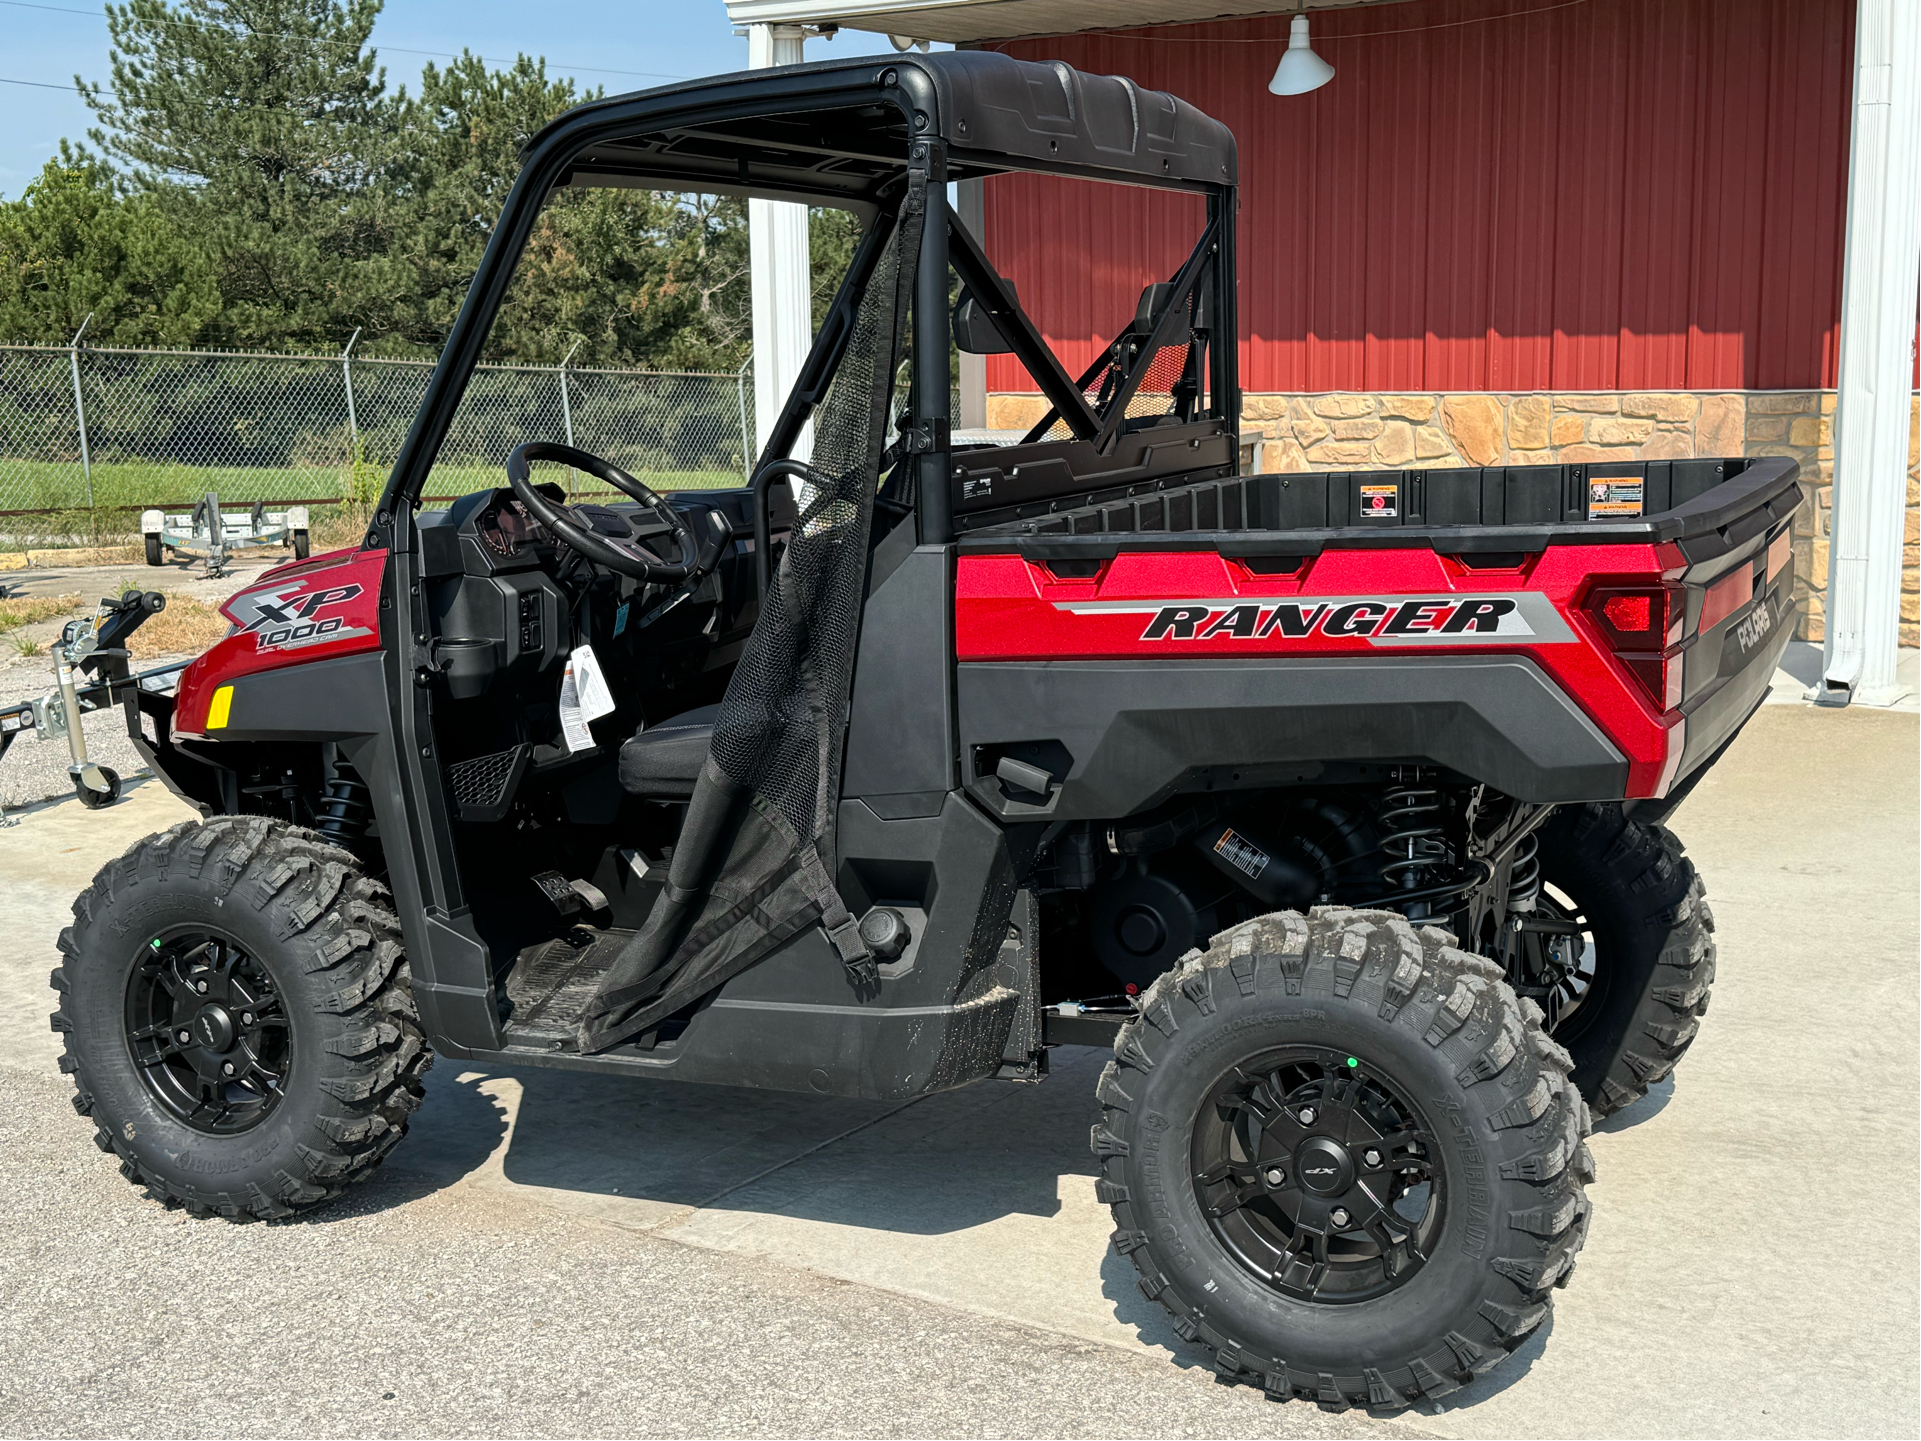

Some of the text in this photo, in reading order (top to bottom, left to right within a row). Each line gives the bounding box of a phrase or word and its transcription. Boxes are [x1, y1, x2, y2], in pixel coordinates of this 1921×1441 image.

[233, 583, 364, 636] XP
[1139, 599, 1518, 640] RANGER
[1737, 601, 1771, 654] POLARIS
[255, 615, 344, 650] 1000
[256, 633, 338, 655] DUAL OVERHEAD CAM
[1302, 1007, 1327, 1021] 8PR
[1304, 1167, 1337, 1175] XP
[1433, 1093, 1489, 1260] X-TERRAIN
